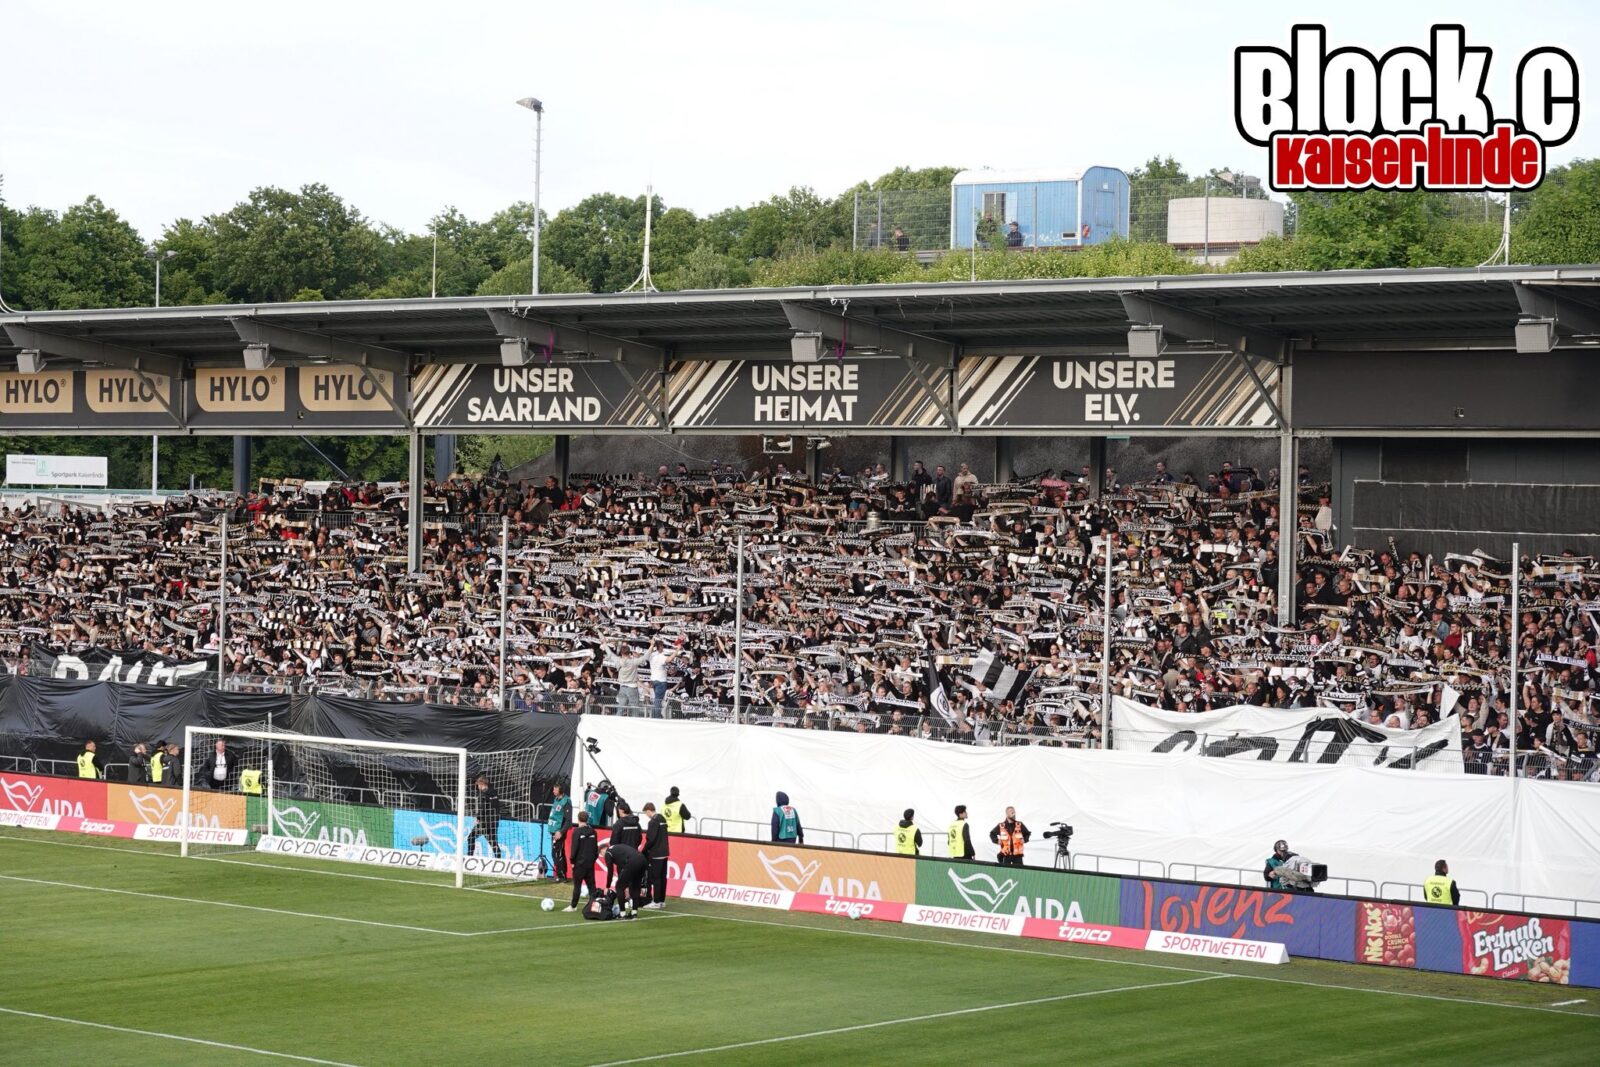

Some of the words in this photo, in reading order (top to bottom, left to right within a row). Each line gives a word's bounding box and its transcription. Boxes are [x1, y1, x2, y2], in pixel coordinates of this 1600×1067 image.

[493, 367, 575, 393] UNSER
[751, 364, 859, 391] UNSERE
[1052, 360, 1175, 389] UNSERE
[5, 378, 60, 404] HYLO
[99, 377, 155, 403] HYLO
[209, 375, 270, 402] HYLO
[314, 374, 377, 401] HYLO
[467, 396, 601, 422] SAARLAND
[753, 395, 858, 422] HEIMAT
[1084, 393, 1140, 421] ELV.
[0, 811, 50, 827] ORTWETTEN
[41, 798, 85, 818] AIDA
[79, 818, 116, 833] tipico
[148, 827, 234, 842] SPORWETTEN
[317, 825, 369, 846] AIDA
[277, 838, 342, 857] ICYDICE
[360, 848, 431, 867] ICYDICE
[463, 857, 537, 876] CYDICE
[667, 860, 698, 881] DA
[694, 883, 781, 906] SPORTWETTEN
[818, 875, 883, 901] AIDA
[916, 908, 1010, 931] SPORTWETTEN
[1013, 895, 1085, 923] AIDA
[1058, 921, 1112, 942] tipico
[1473, 917, 1543, 958] Erdnuß
[1162, 934, 1268, 959] SPORTWETTEN
